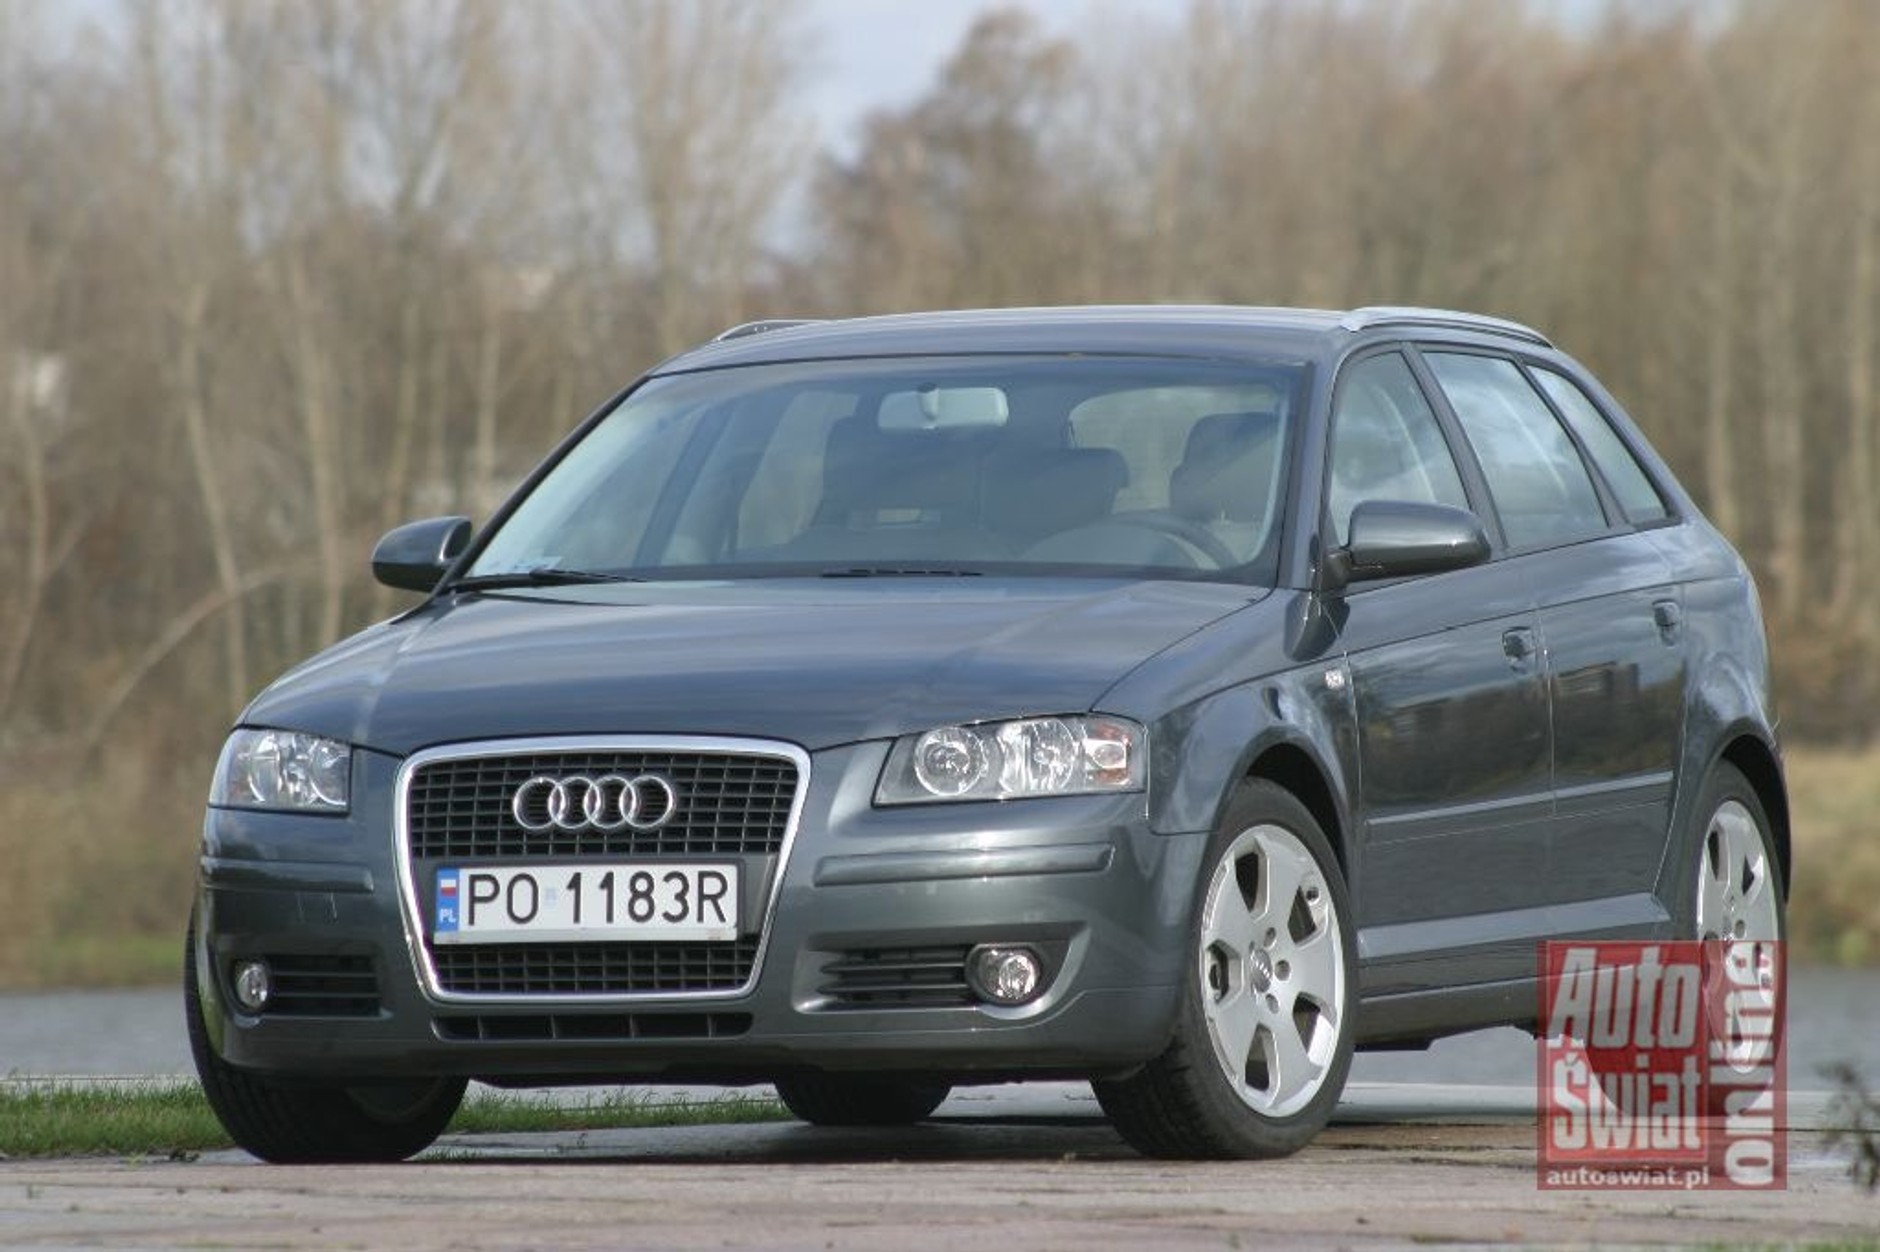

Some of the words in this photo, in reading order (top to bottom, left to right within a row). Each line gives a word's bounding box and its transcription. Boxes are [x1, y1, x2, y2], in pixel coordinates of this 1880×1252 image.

[468, 873, 539, 926] PO
[566, 870, 729, 924] 1183R
[440, 909, 456, 924] PL
